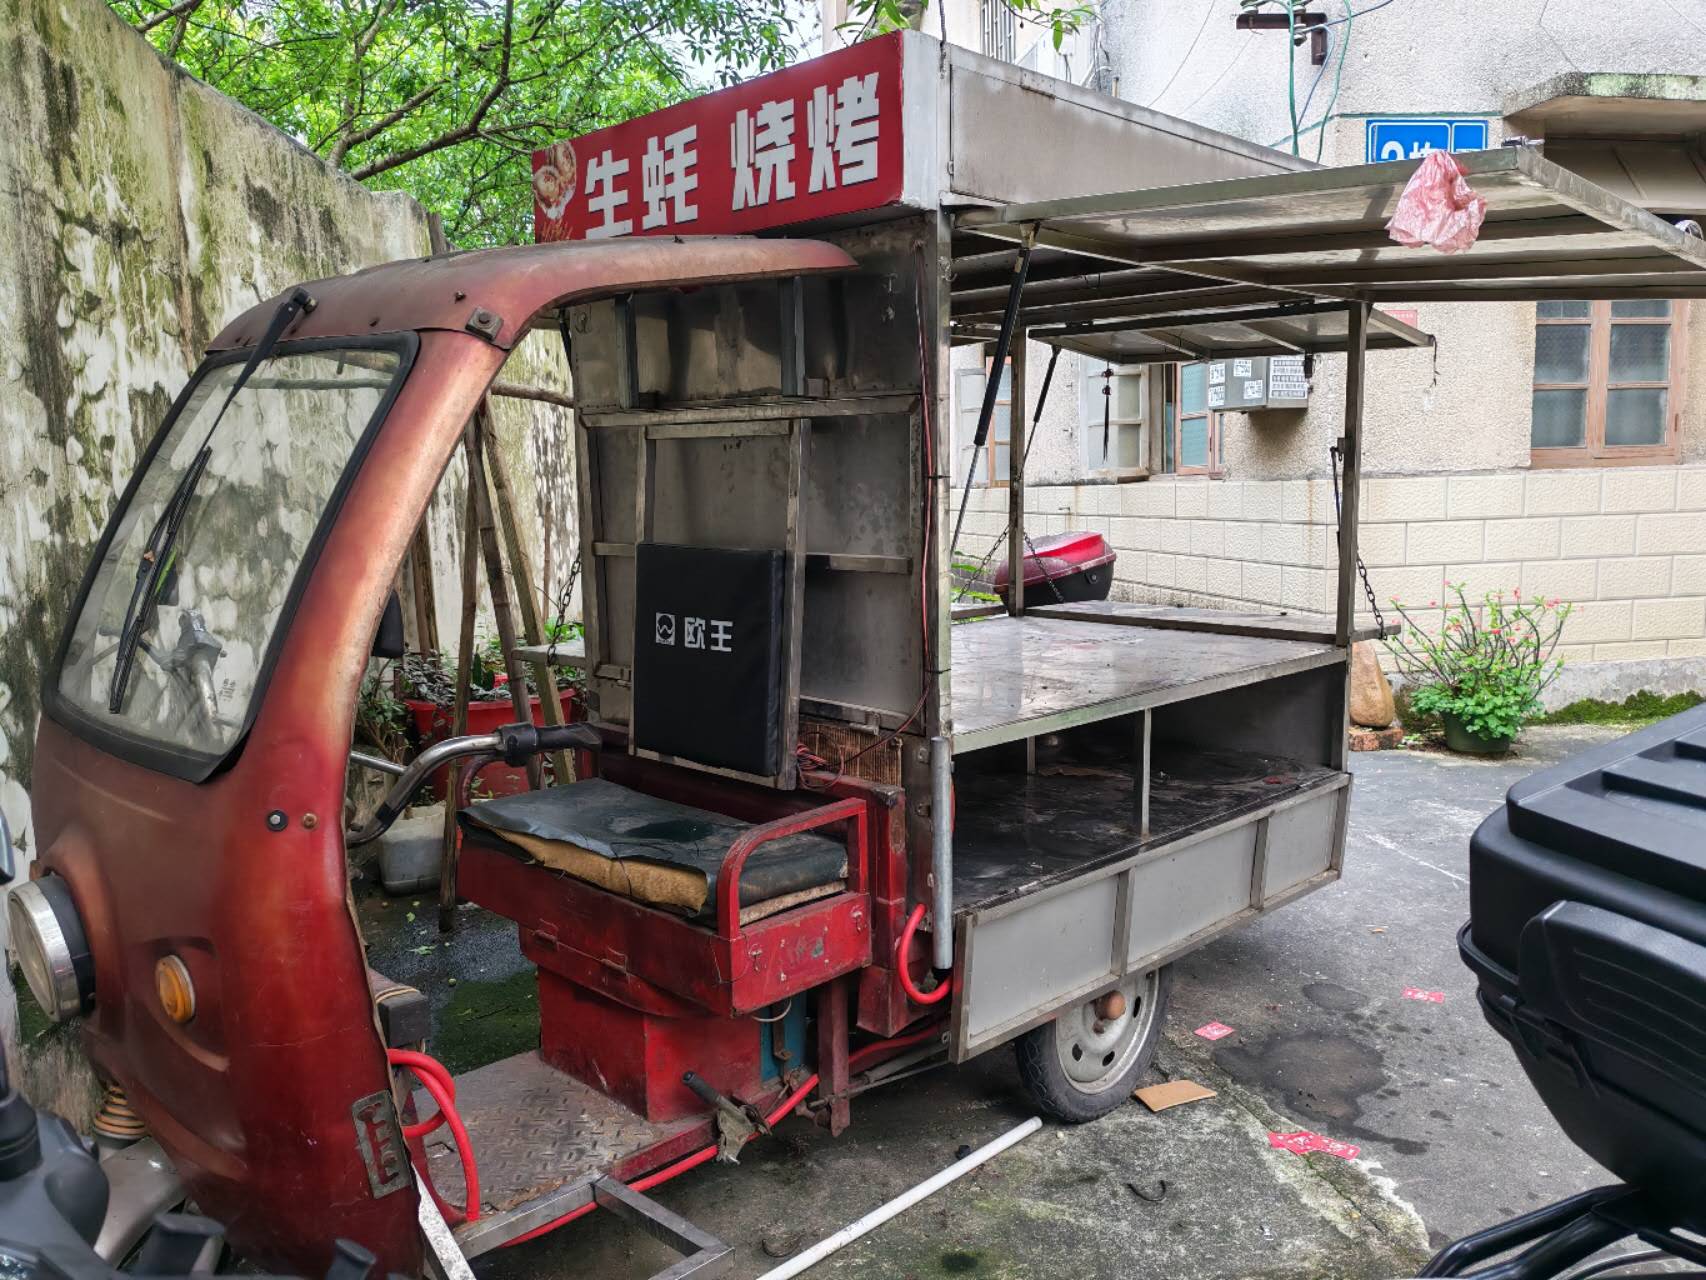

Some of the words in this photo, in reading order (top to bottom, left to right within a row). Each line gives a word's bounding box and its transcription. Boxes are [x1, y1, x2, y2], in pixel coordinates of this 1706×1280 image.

[585, 124, 698, 240] 生蚝
[730, 72, 880, 212] 烧烤
[684, 616, 734, 652] 欧王
